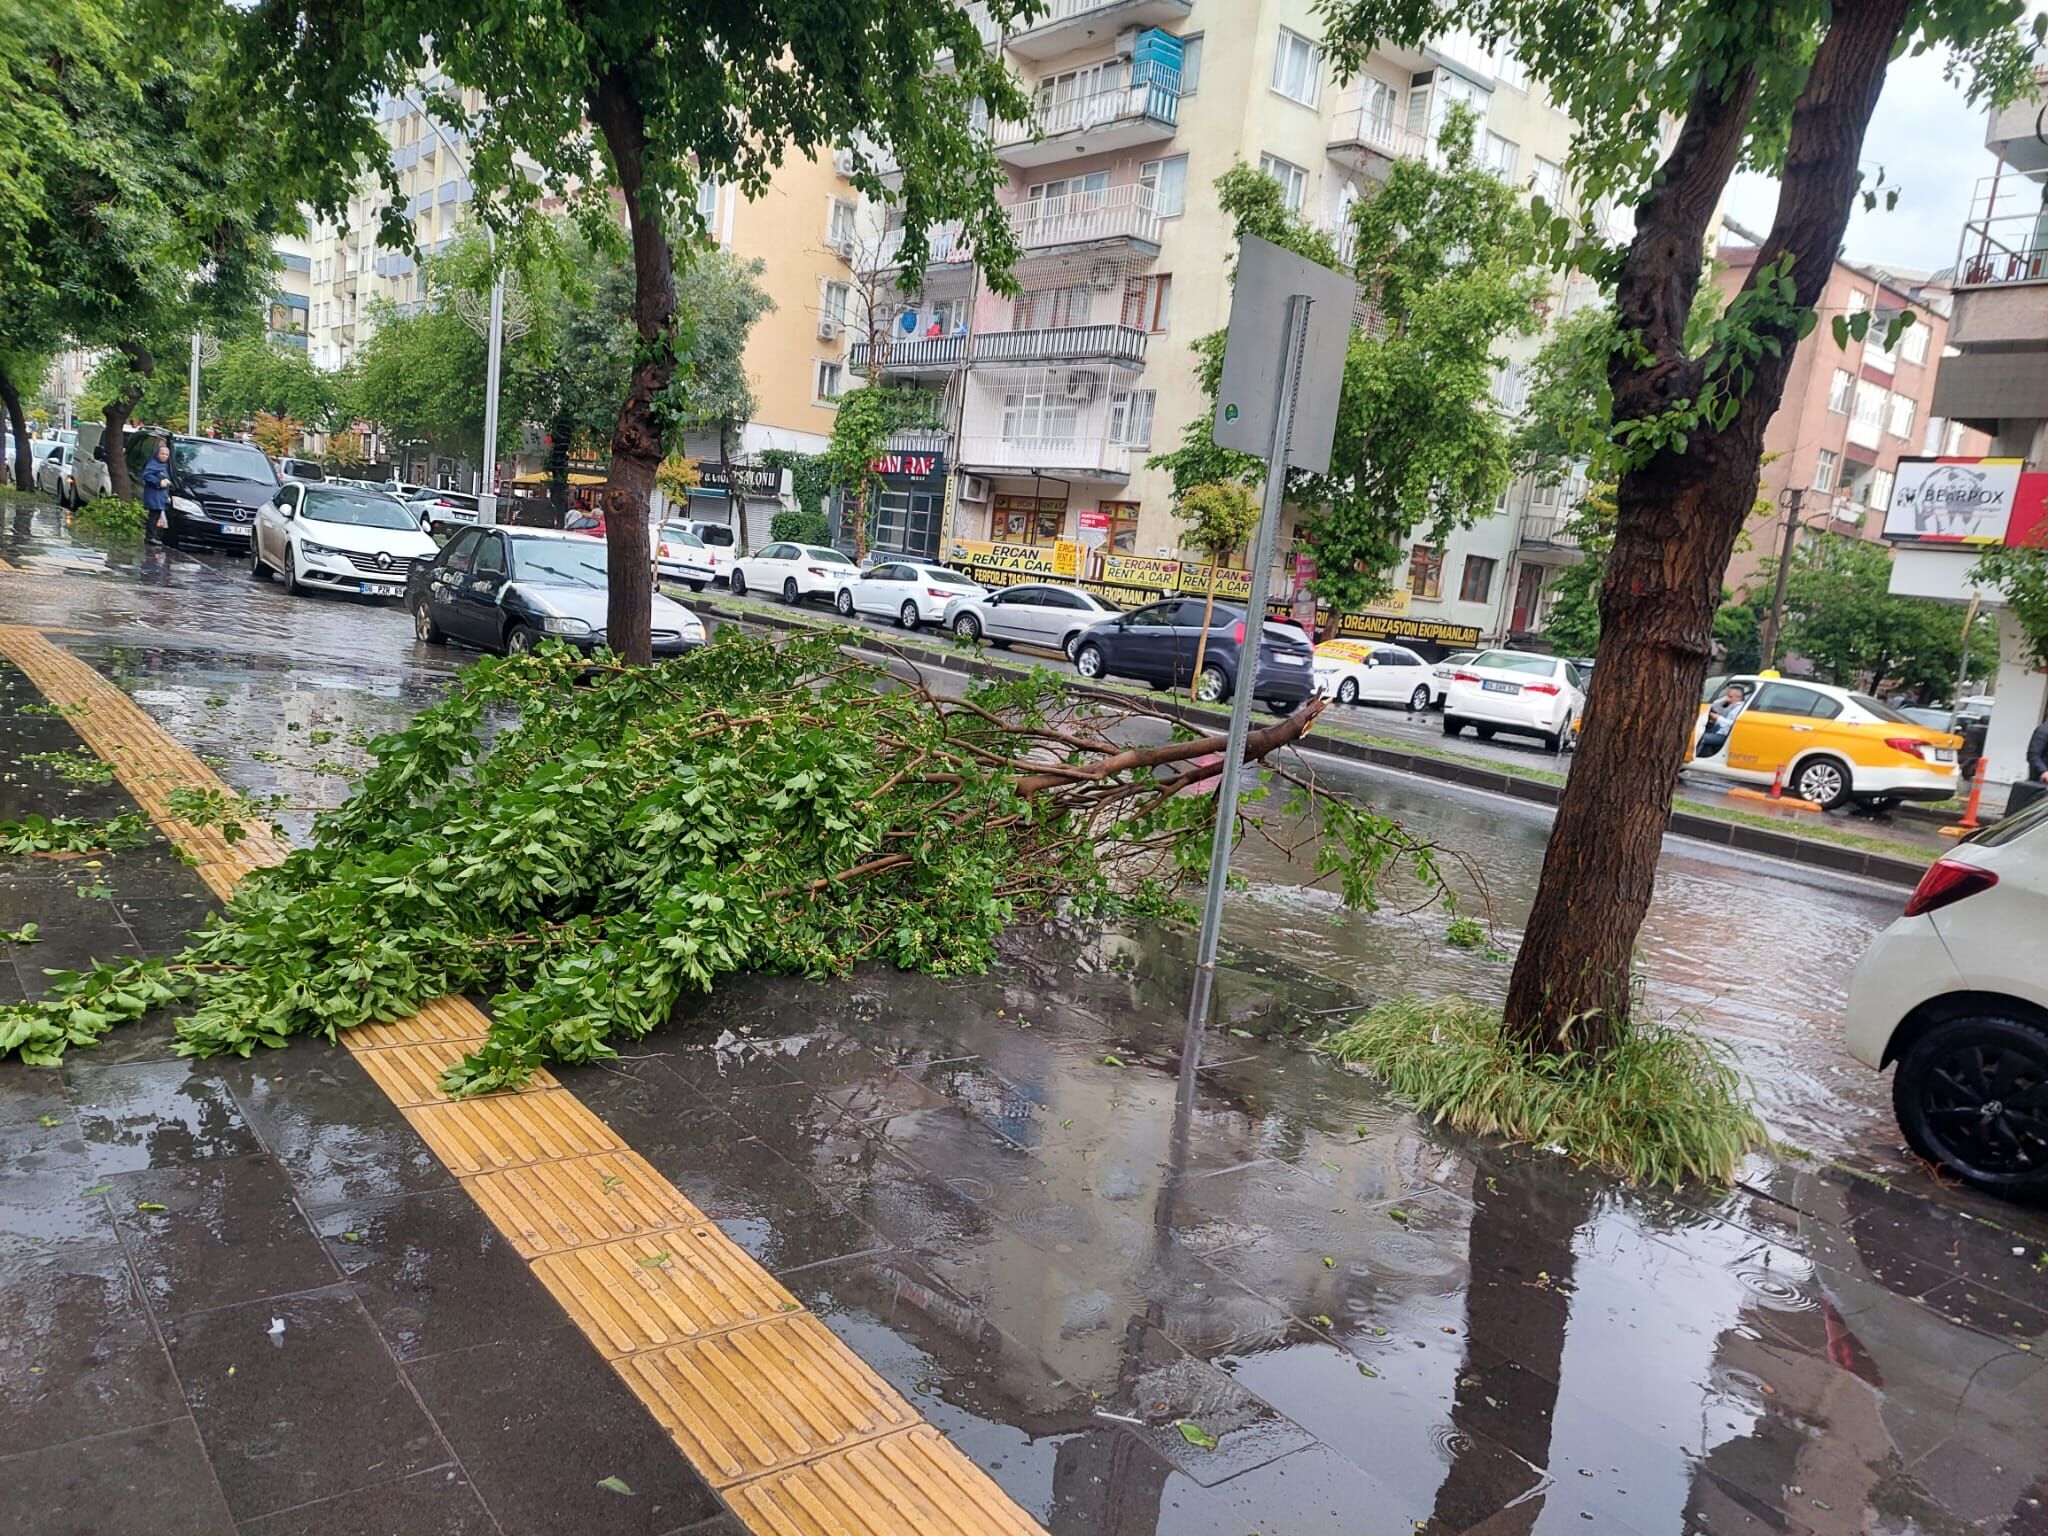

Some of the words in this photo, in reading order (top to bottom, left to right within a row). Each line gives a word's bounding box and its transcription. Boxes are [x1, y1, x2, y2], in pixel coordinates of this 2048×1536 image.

[904, 455, 936, 475] RAF
[1925, 488, 2006, 505] BEARPOX
[992, 545, 1040, 561] ERCAN
[972, 553, 1008, 567] RENT
[1009, 558, 1020, 569] A
[1024, 560, 1053, 573] CAR
[1124, 558, 1161, 571] ERCAN
[975, 568, 1007, 585] FERFORJE
[1108, 567, 1134, 579] RENT
[1138, 570, 1146, 581] A
[1149, 572, 1172, 584] CAR
[1215, 580, 1224, 590] A
[1227, 581, 1250, 593] CAR
